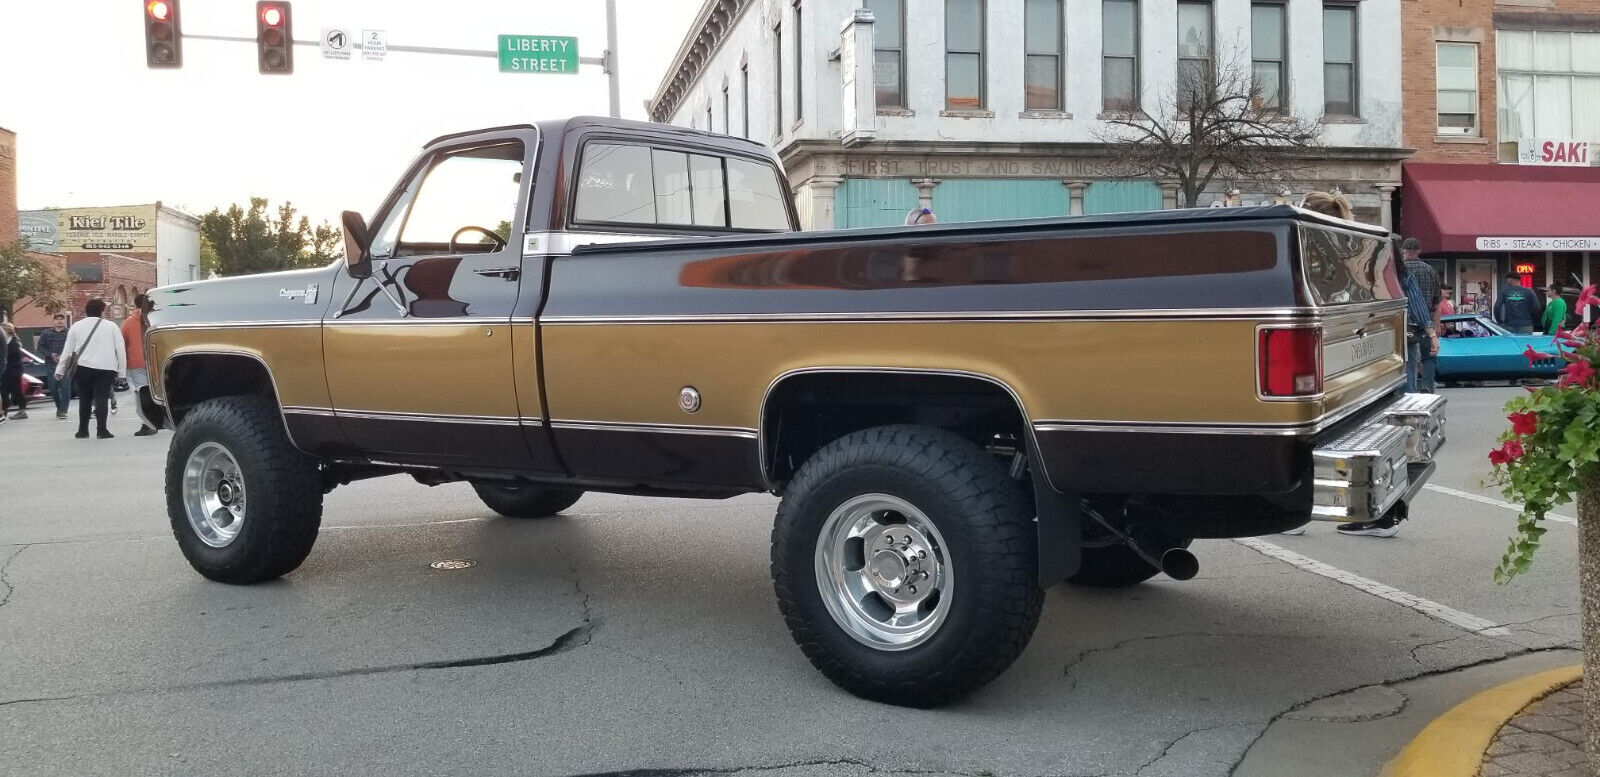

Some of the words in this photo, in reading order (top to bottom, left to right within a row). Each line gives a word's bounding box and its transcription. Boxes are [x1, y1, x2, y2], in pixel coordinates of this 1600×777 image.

[371, 32, 378, 40] 2
[508, 38, 569, 52] LIBERTY
[511, 57, 567, 72] STREET
[1542, 141, 1588, 163] SAKi
[849, 160, 899, 175] FIRST
[916, 160, 973, 175] TRUST
[986, 162, 1019, 175] AND
[1032, 162, 1105, 176] SAVINGS
[69, 215, 107, 231] Kief
[109, 215, 145, 231] Tile
[1483, 239, 1501, 248] RIBS
[1512, 239, 1543, 249] STEAKS
[1552, 239, 1591, 249] CHICKEN
[1516, 264, 1534, 273] OPEN
